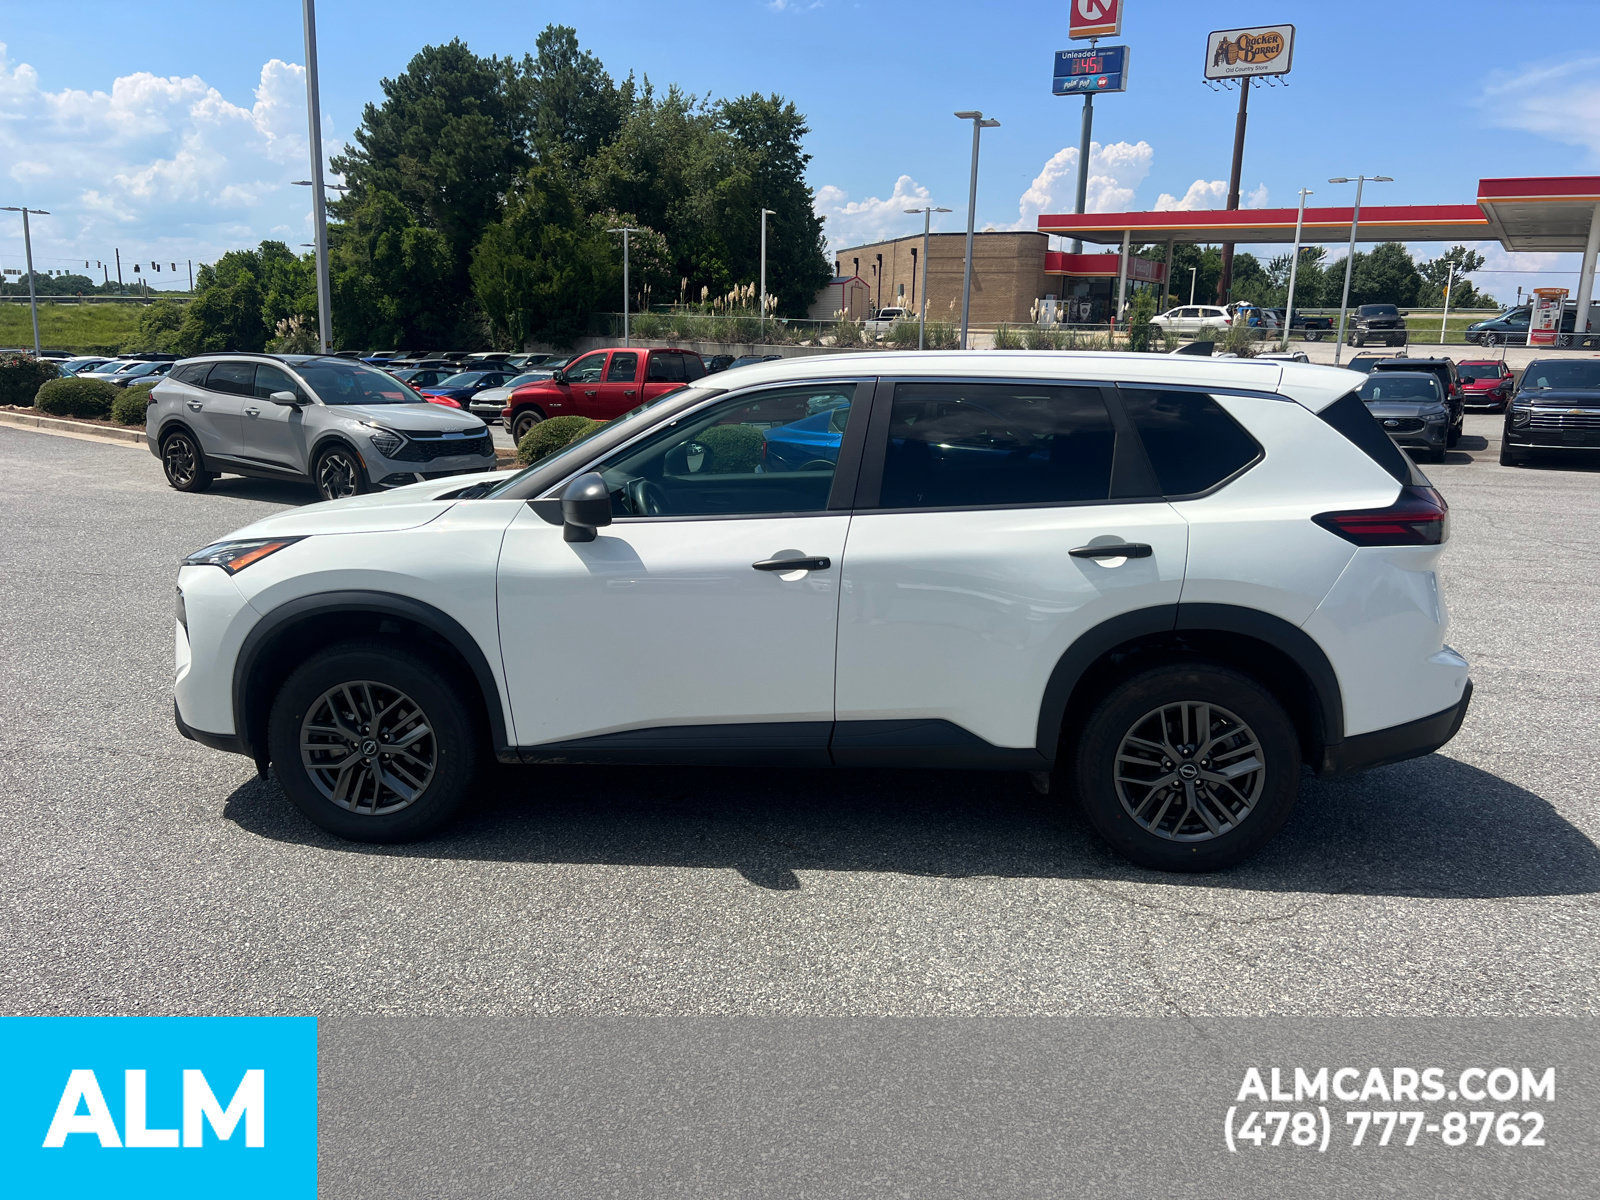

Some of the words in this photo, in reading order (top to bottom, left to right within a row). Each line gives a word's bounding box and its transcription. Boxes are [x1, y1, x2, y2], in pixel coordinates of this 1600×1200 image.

[1238, 35, 1279, 51] Cracker
[1062, 50, 1097, 60] Unleaded
[1245, 44, 1280, 62] Barrel
[1235, 65, 1254, 73] Country
